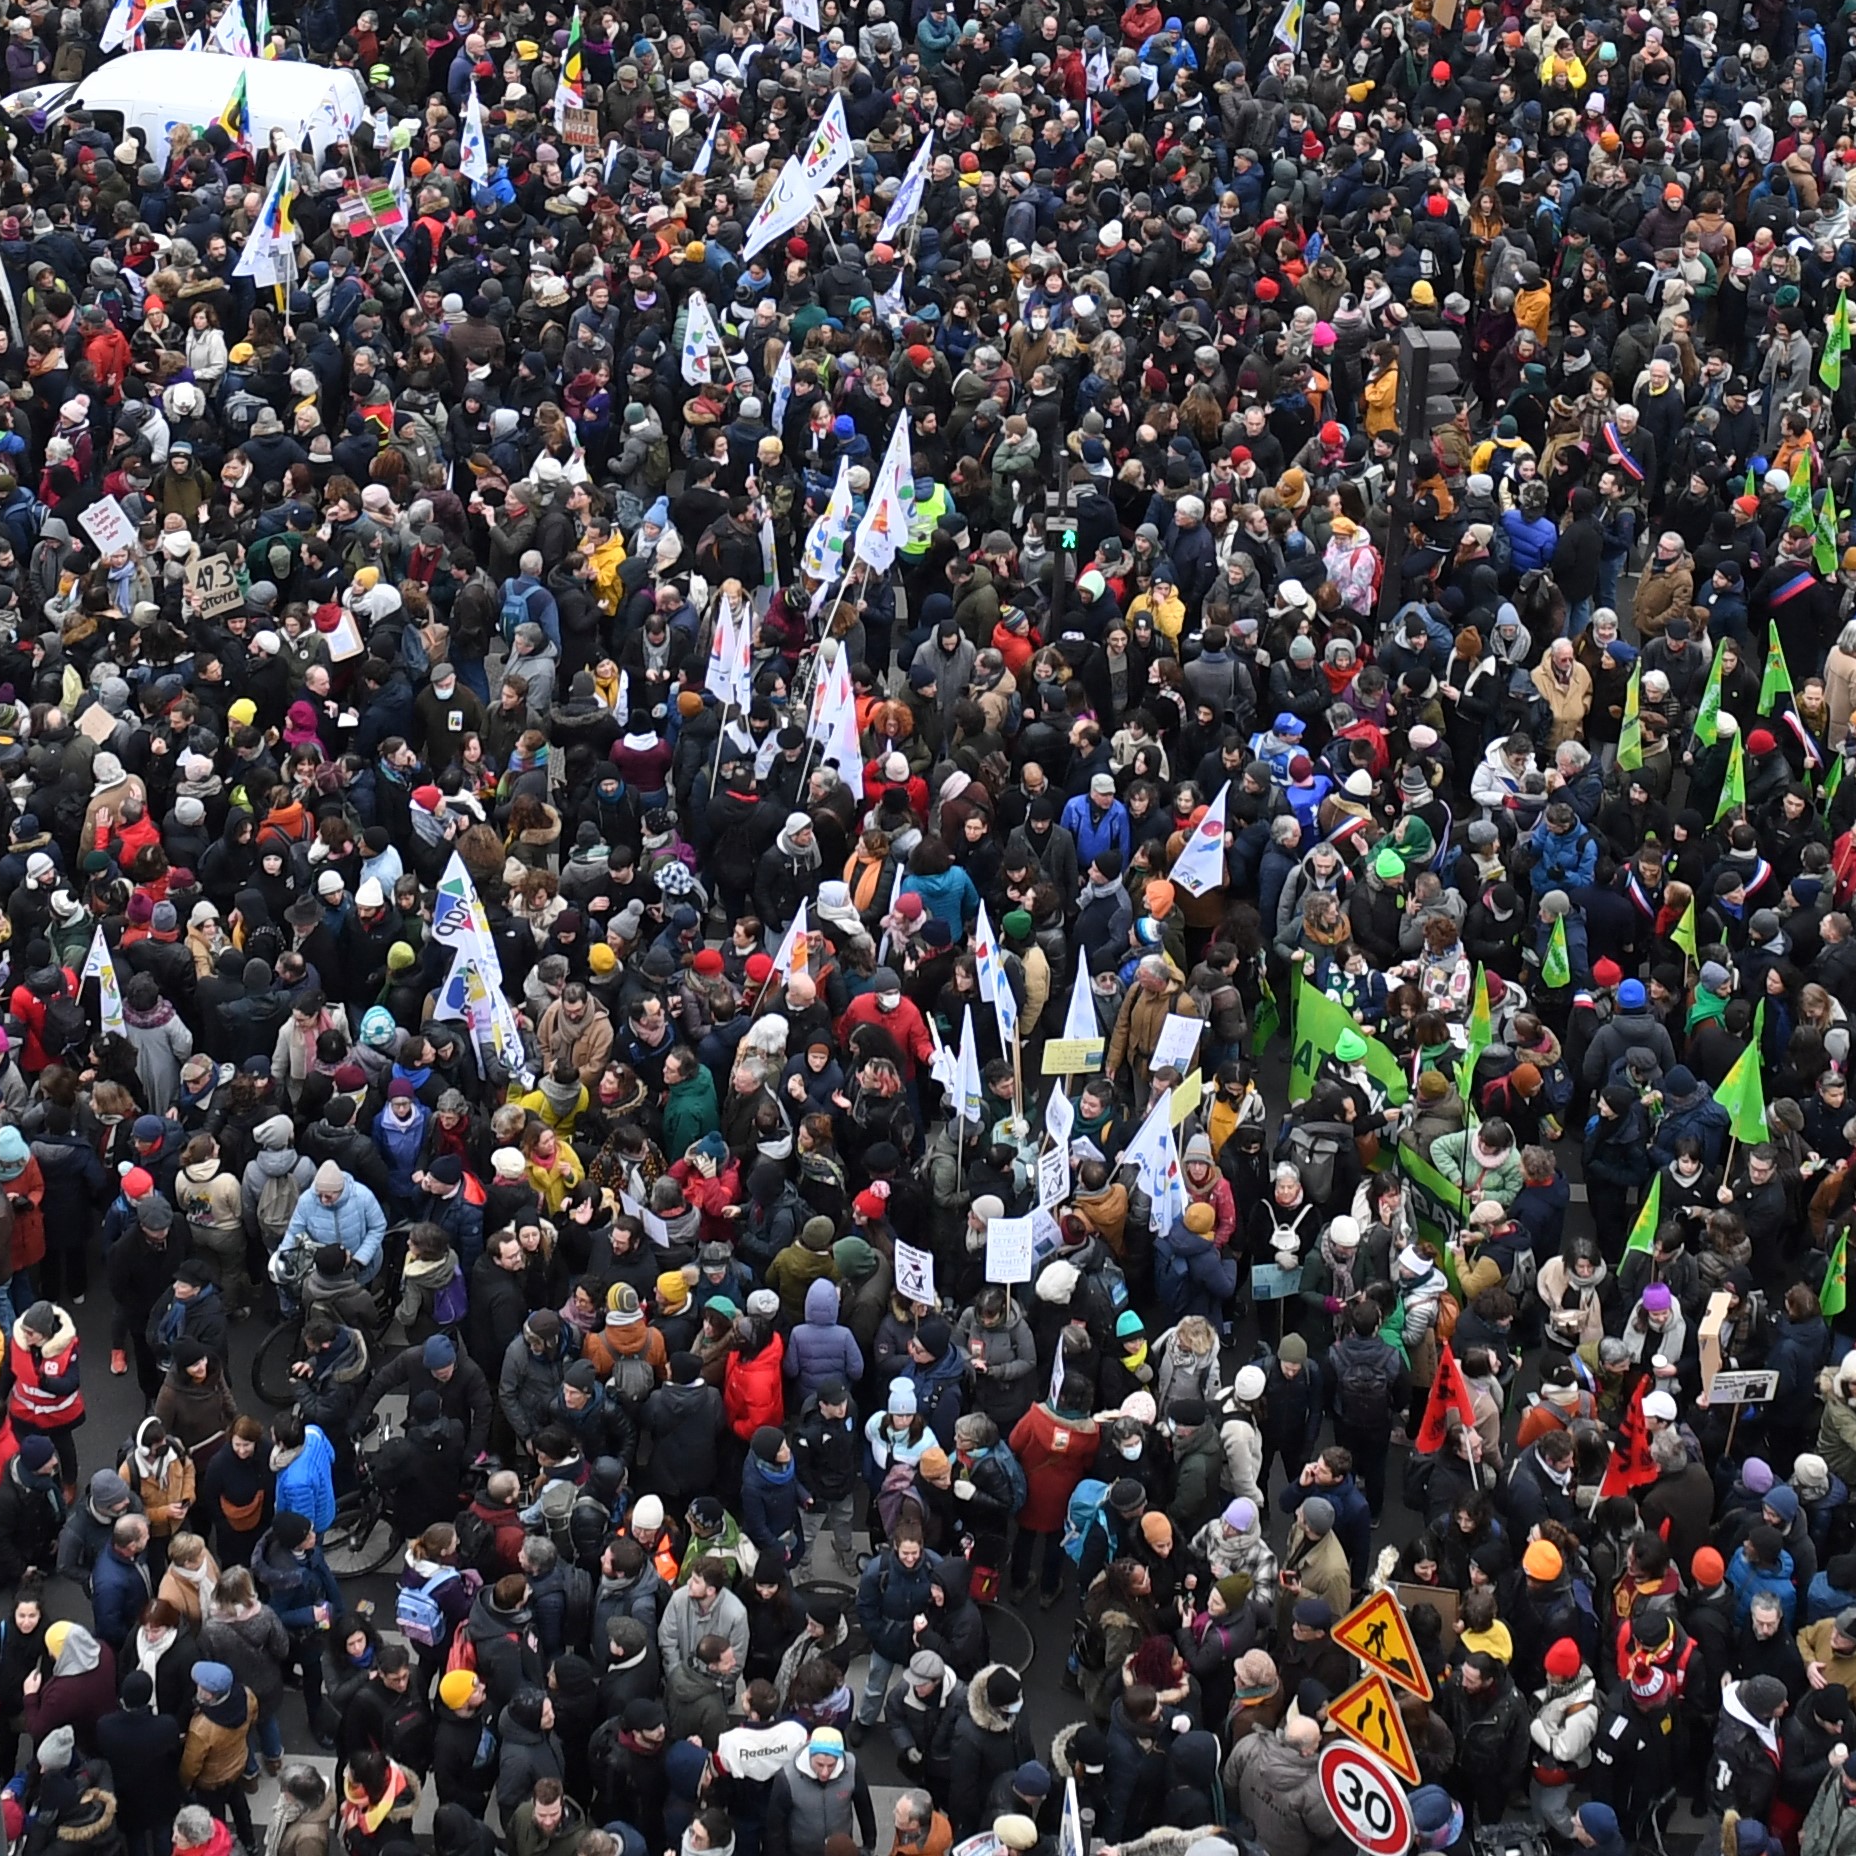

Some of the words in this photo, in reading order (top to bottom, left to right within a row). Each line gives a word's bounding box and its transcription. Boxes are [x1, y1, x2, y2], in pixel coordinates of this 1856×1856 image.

[196, 560, 234, 593] 49.3
[739, 1744, 788, 1760] Reebok
[1338, 1768, 1392, 1834] 30
